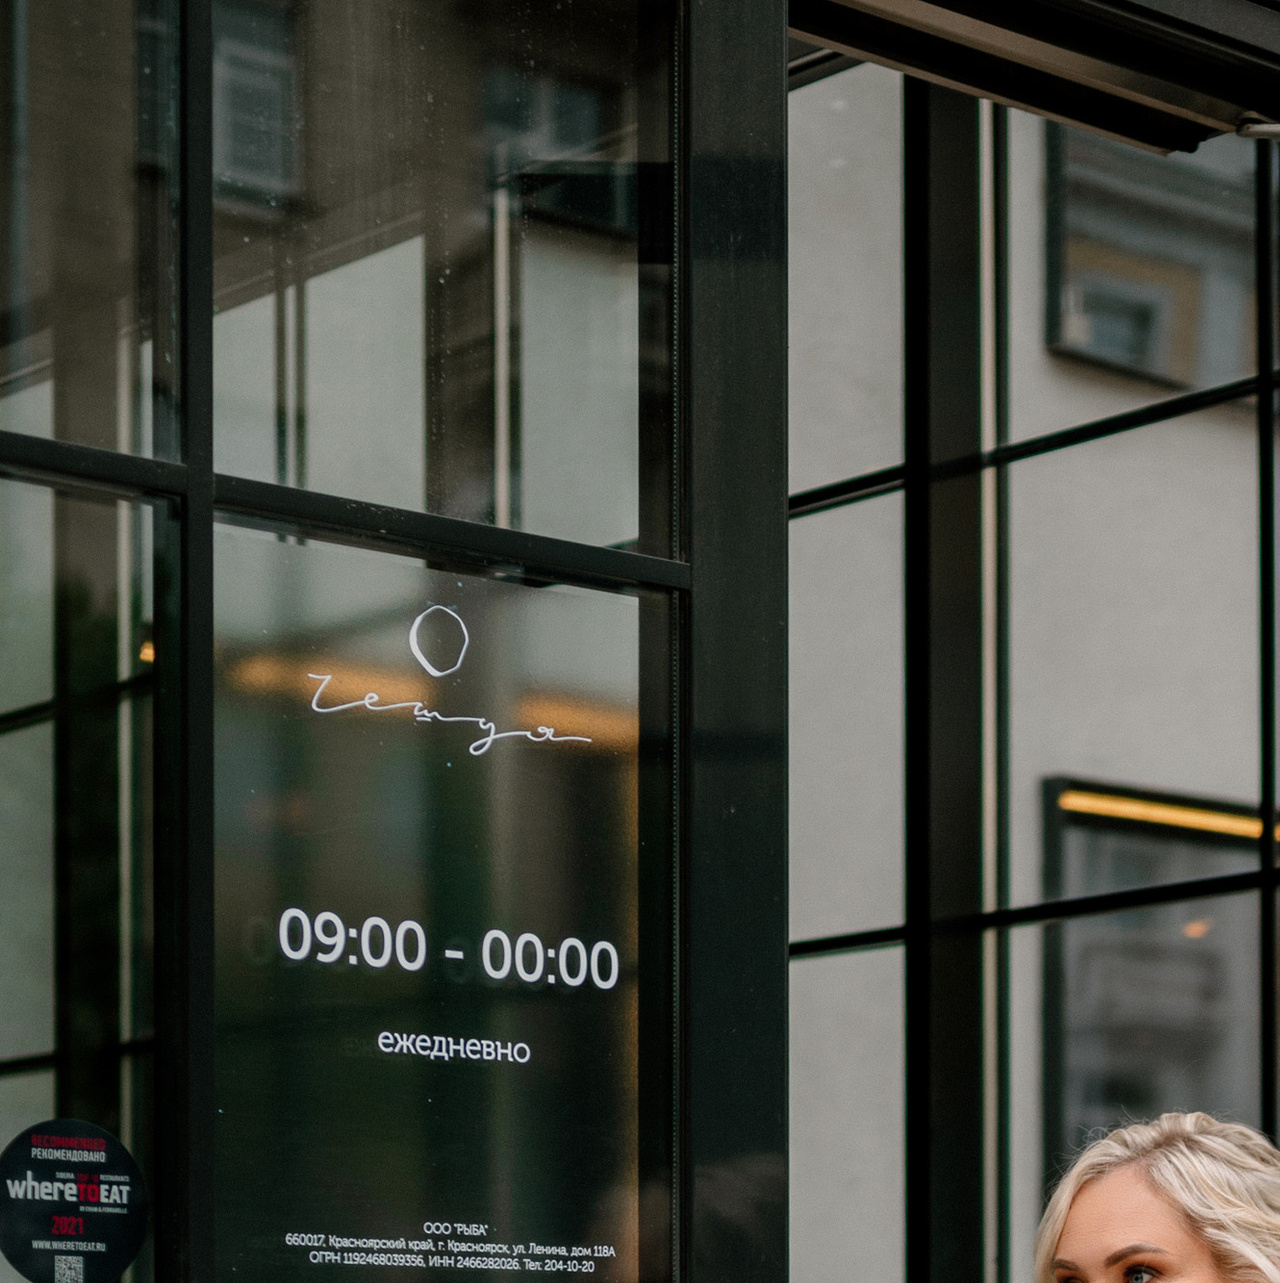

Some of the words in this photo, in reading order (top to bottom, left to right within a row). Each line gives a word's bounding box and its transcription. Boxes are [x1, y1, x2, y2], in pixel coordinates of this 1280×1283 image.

[278, 907, 427, 972] 09:00
[444, 947, 465, 961] -
[481, 929, 620, 990] 00:00
[377, 1030, 531, 1064] ежедневно
[31, 1134, 106, 1151] RECOMMENDED
[31, 1147, 107, 1162] РЕКОМЕНДОВАНО
[51, 1215, 85, 1236] 2021
[423, 1222, 451, 1235] ООО
[31, 1239, 107, 1252] WWW.WHERETOEAT.RU
[328, 1235, 406, 1250] Красноярский
[438, 1241, 445, 1251] г.
[570, 1246, 592, 1257] дом
[593, 1245, 616, 1258] 118А
[309, 1250, 341, 1264] ОГРН
[428, 1255, 455, 1267] ИНН
[544, 1259, 596, 1273] 204-10-20
